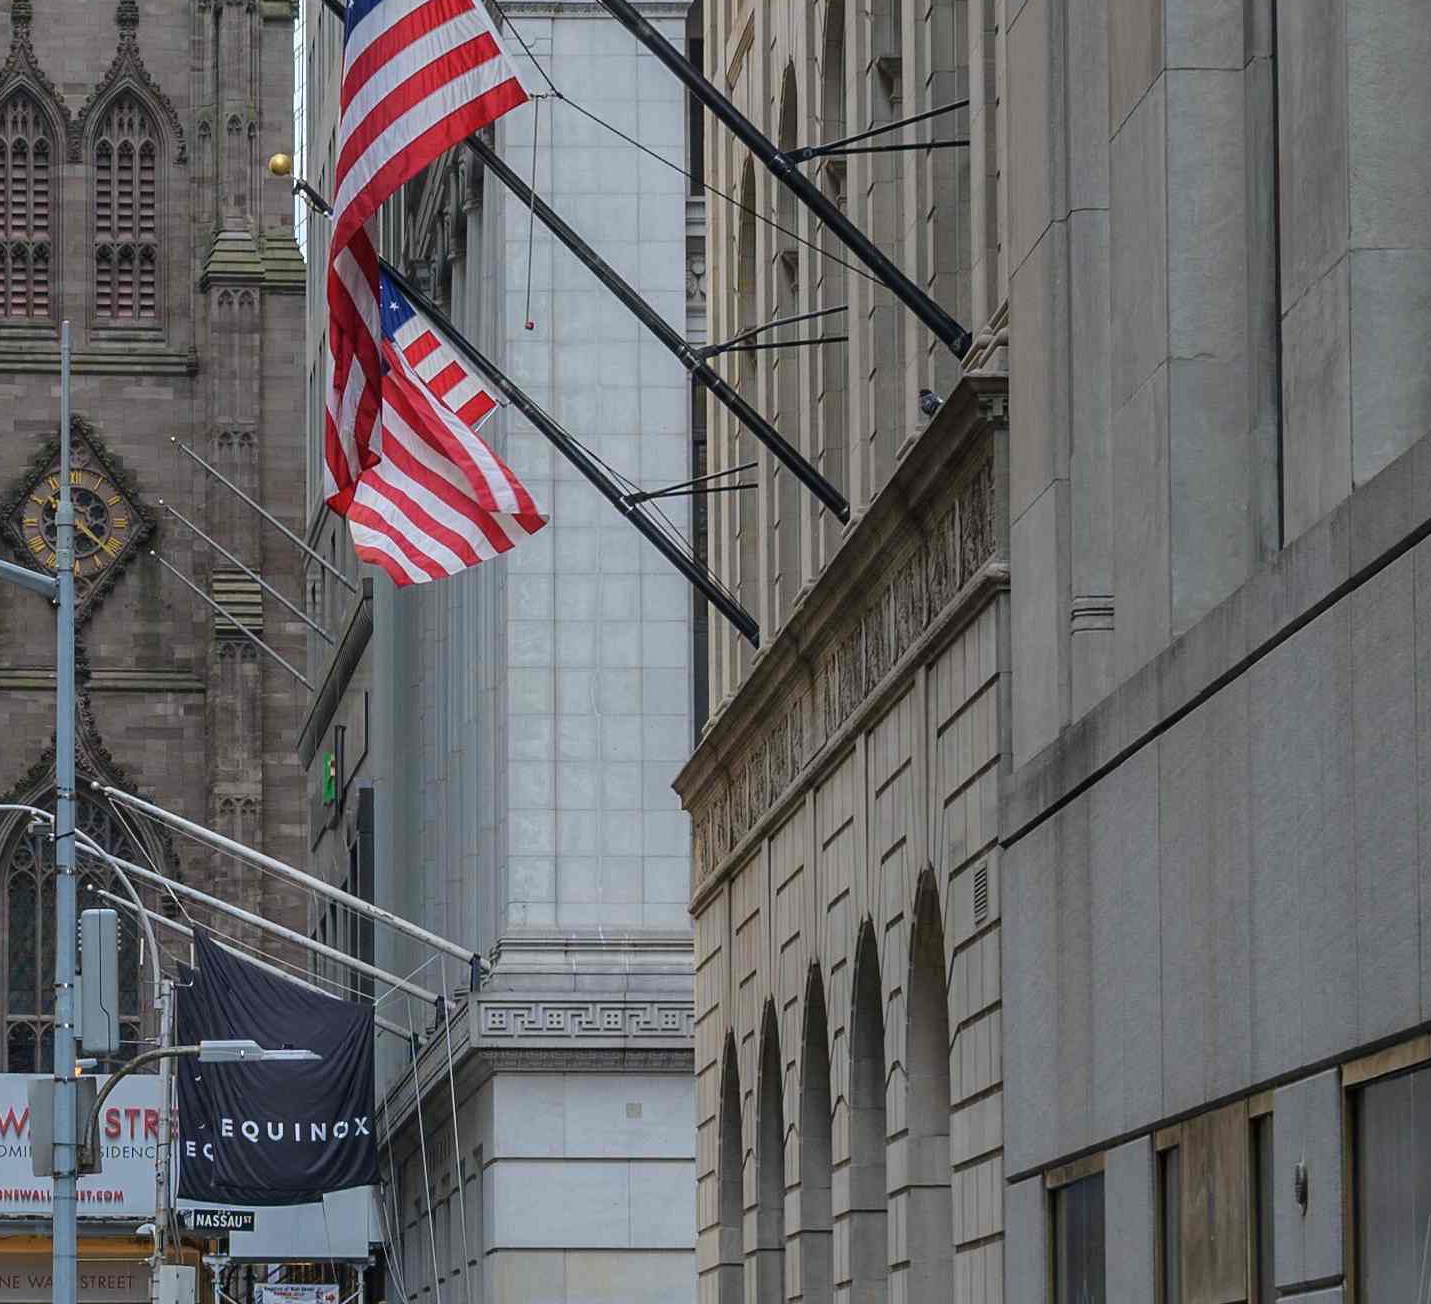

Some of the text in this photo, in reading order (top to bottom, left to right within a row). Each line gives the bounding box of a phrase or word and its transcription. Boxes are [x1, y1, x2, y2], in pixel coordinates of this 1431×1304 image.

[221, 1116, 370, 1143] EQUINOX
[196, 1214, 242, 1228] NASSAU
[27, 1276, 53, 1289] WA
[81, 1276, 134, 1289] STREET
